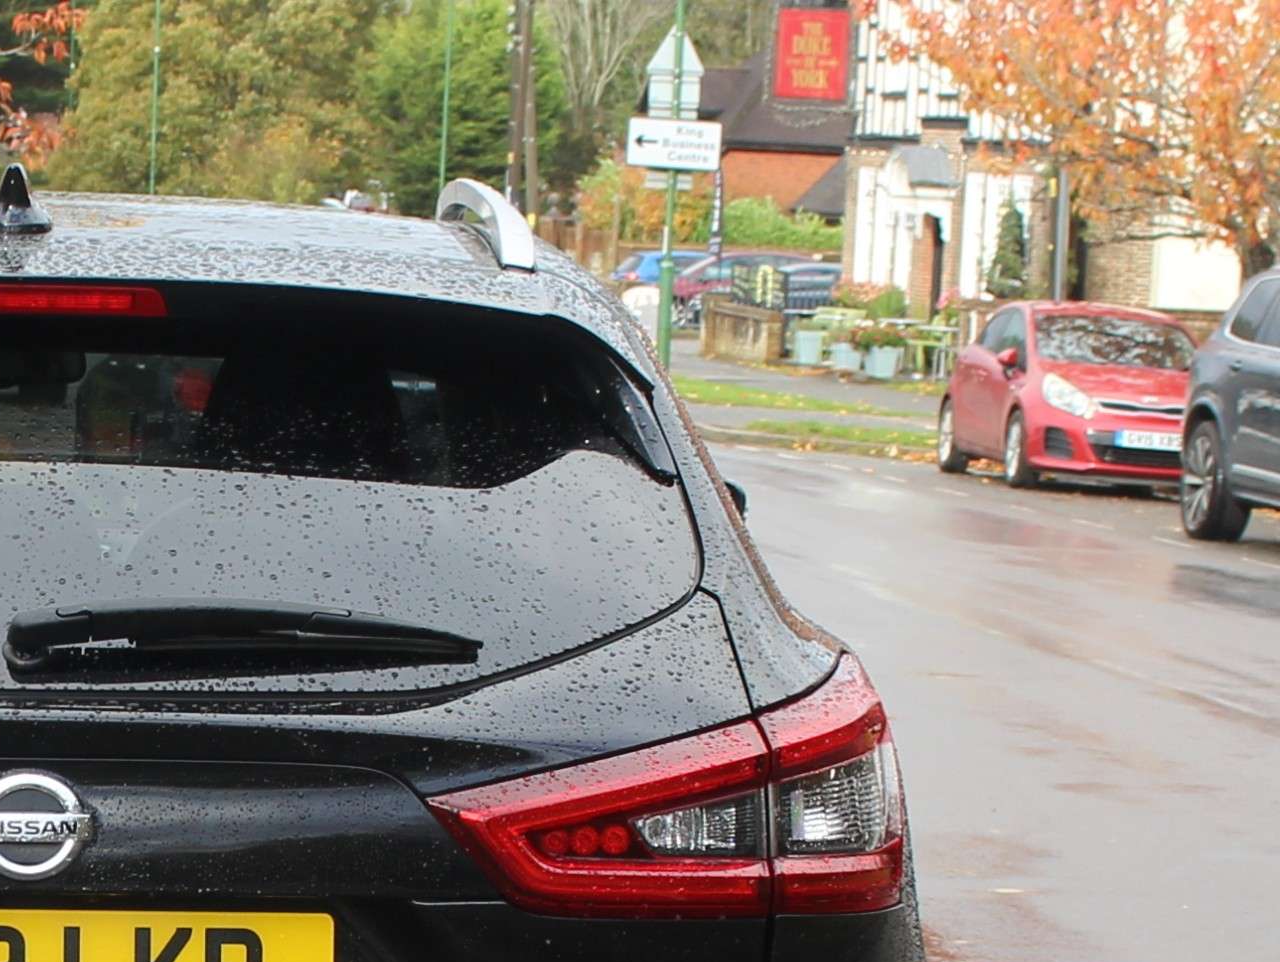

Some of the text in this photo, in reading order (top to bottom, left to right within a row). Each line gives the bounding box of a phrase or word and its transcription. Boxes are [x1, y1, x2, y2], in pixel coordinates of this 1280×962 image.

[792, 34, 832, 56] DUKE
[791, 68, 829, 89] YORK
[676, 126, 704, 139] King
[662, 137, 716, 151] Business
[667, 150, 709, 163] Centre
